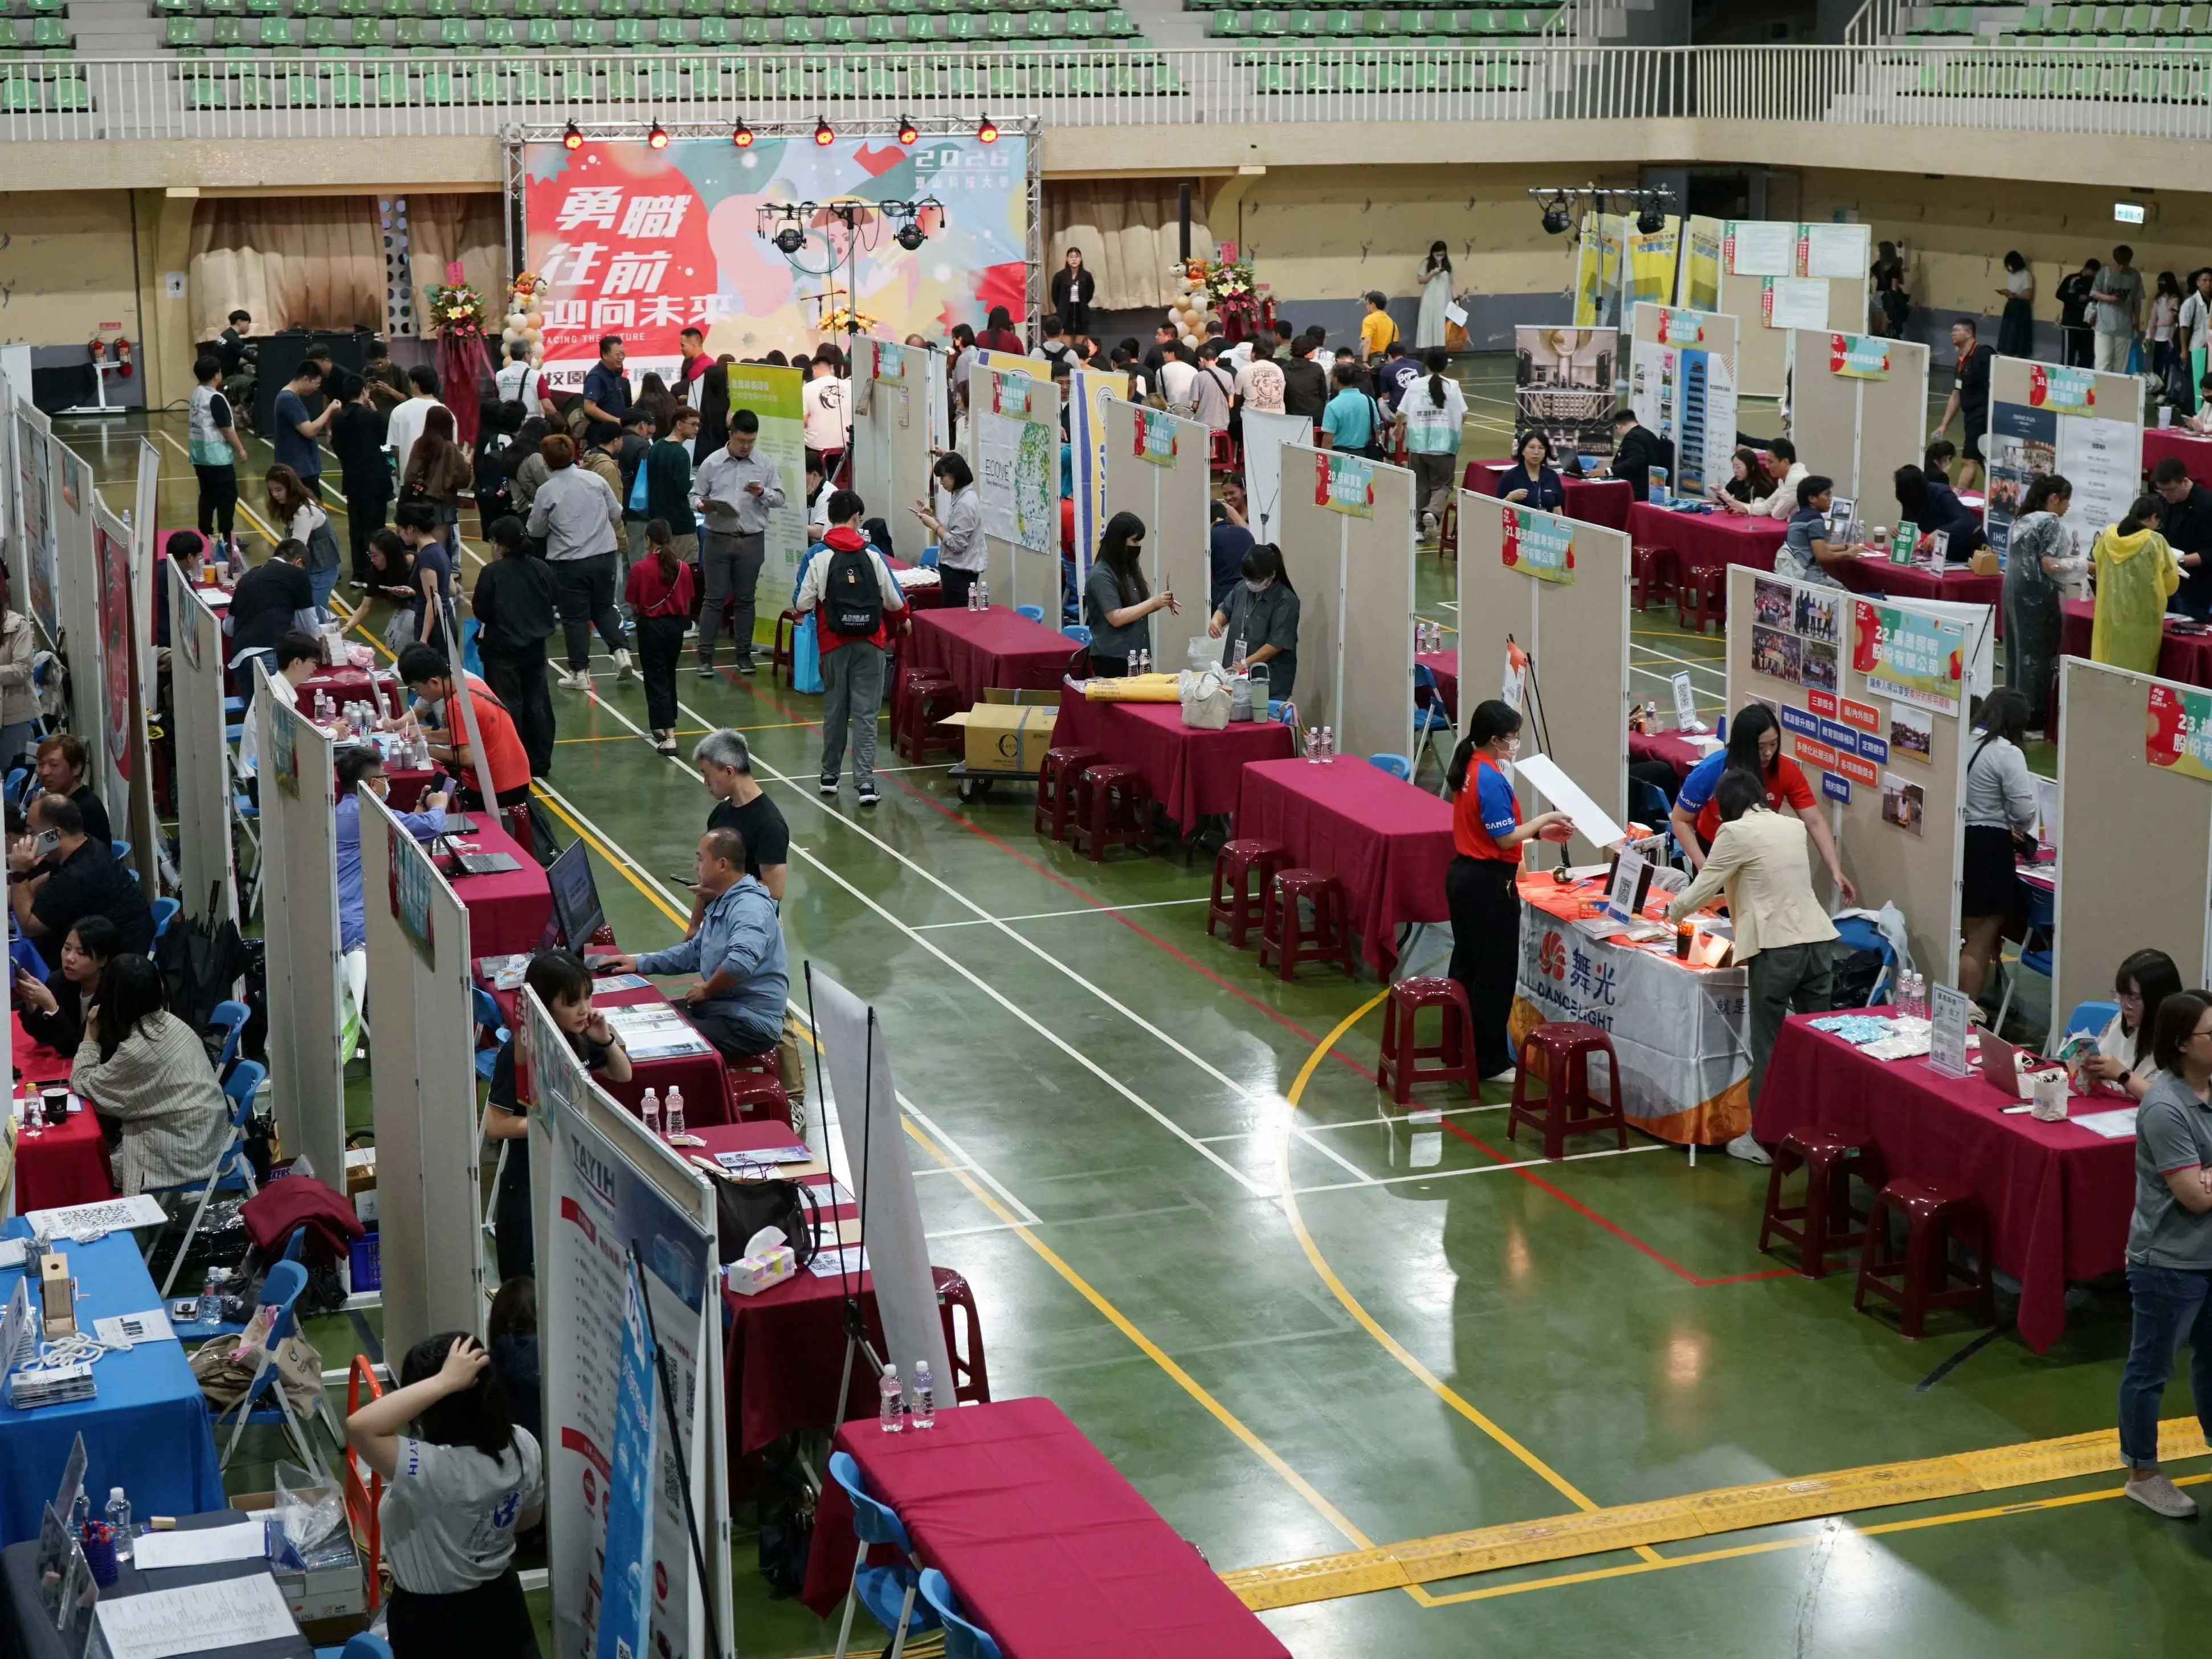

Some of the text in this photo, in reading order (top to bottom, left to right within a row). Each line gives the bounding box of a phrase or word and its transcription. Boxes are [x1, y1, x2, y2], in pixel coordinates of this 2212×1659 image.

[915, 150, 1009, 167] 2026
[555, 186, 693, 239] 勇職
[539, 242, 673, 295] 往前
[541, 293, 734, 332] 迎向未來
[985, 459, 1010, 482] ECOVE
[1992, 530, 2007, 544] IHG
[841, 614, 871, 623] ADIDAS
[1872, 643, 1939, 676] 股份有限公司
[1569, 947, 1616, 1006] 舞光
[1538, 981, 1614, 1033] DANCELIGHT
[571, 1133, 616, 1200] TAYIH
